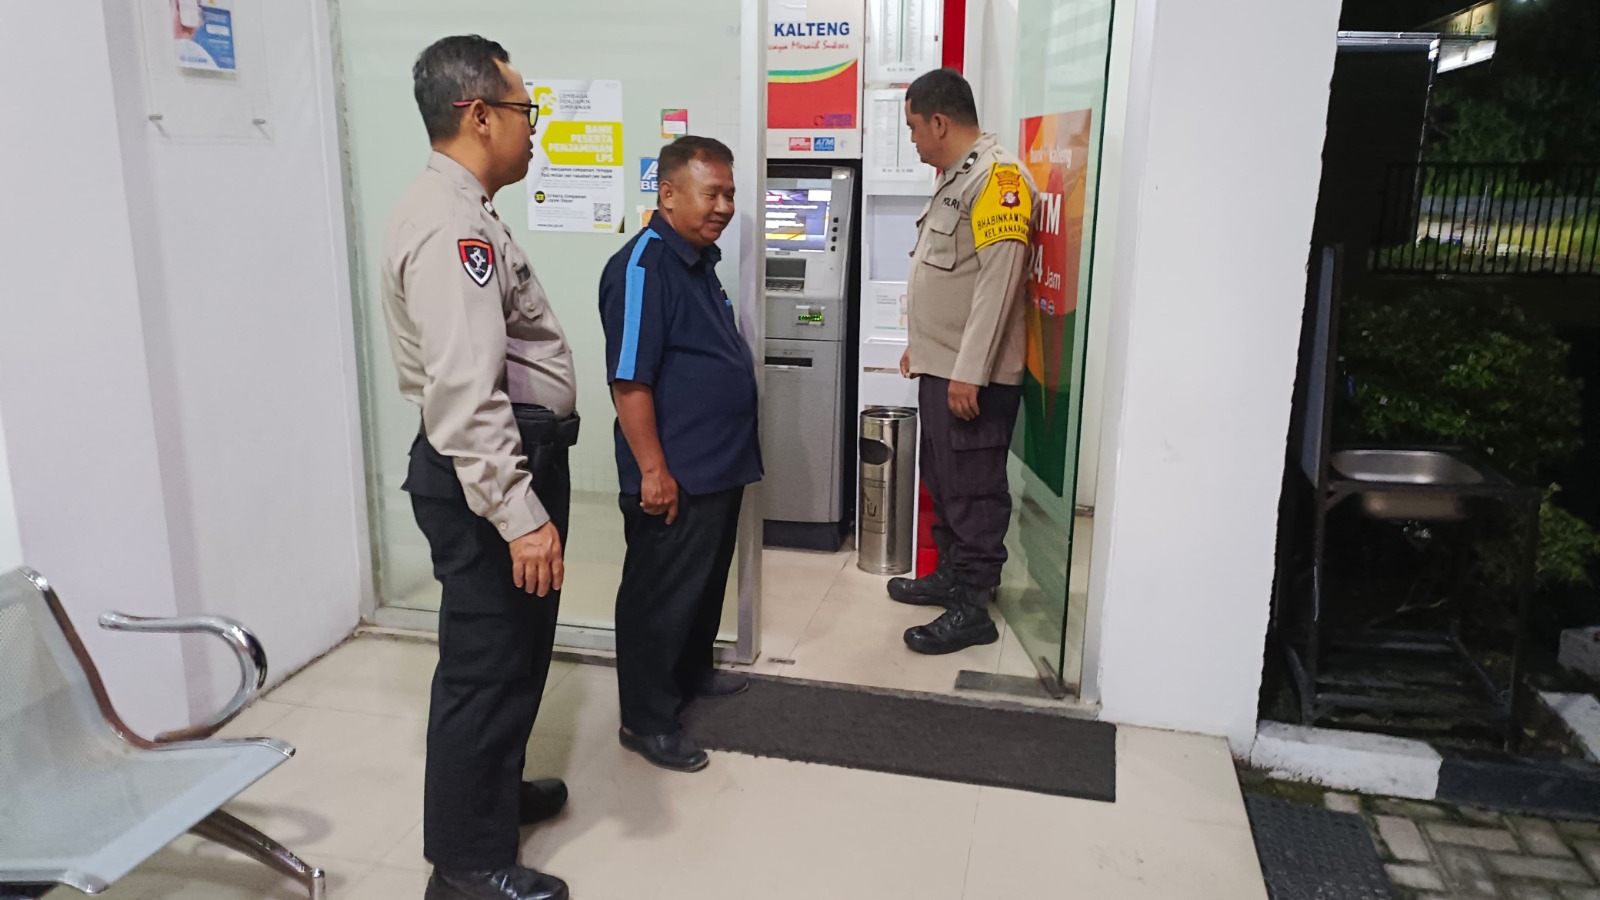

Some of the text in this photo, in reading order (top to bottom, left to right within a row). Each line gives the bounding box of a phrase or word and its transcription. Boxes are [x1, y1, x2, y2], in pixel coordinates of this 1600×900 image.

[774, 22, 850, 37] KALTENG
[585, 124, 613, 134] BANK
[571, 134, 613, 143] PESERTA
[596, 153, 614, 163] LPS
[1035, 192, 1062, 236] TM
[1044, 266, 1060, 291] Jam
